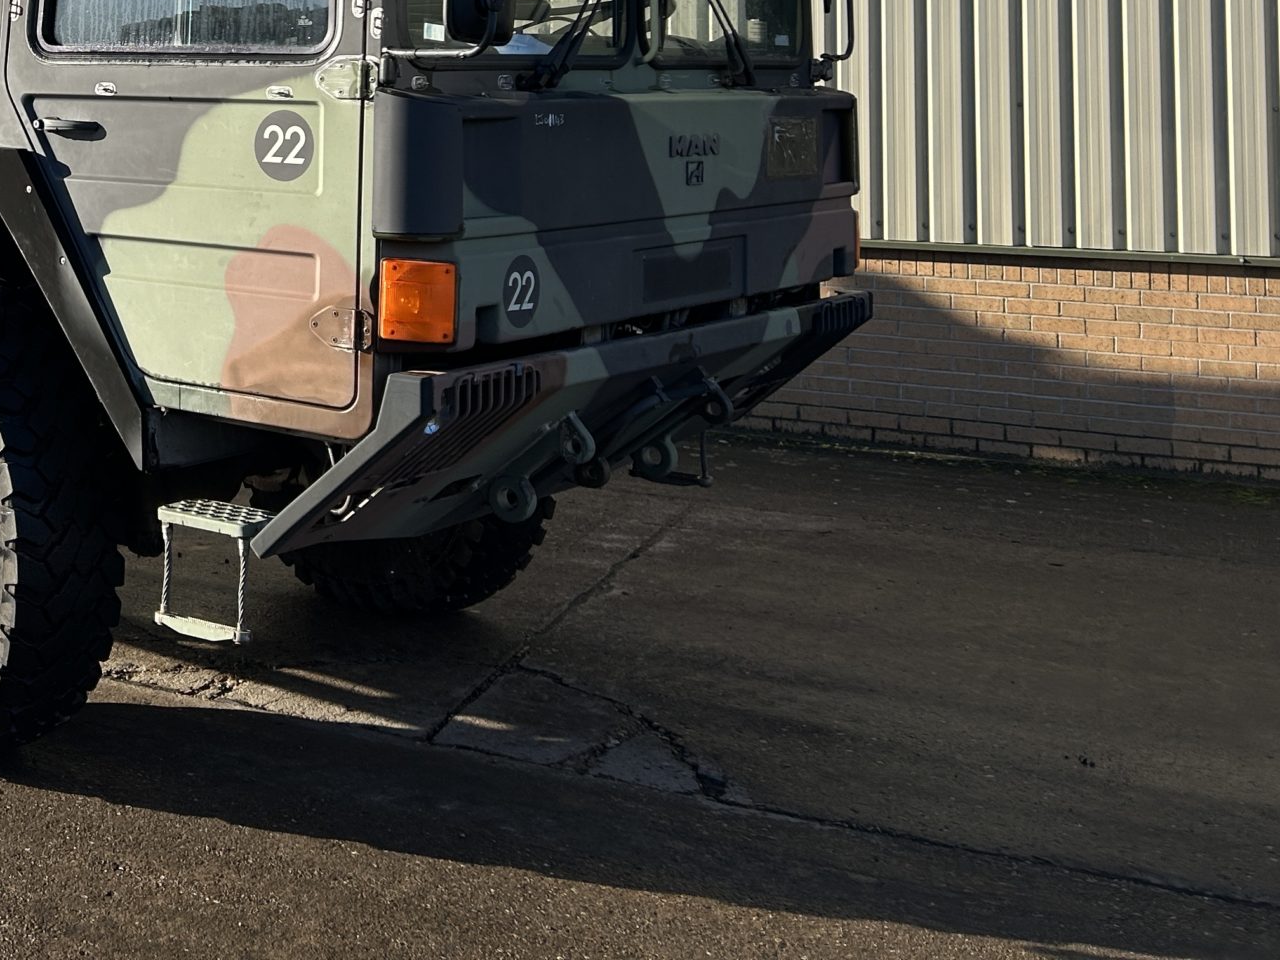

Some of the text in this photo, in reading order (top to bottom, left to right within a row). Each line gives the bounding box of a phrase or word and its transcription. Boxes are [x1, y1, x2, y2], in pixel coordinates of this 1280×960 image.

[262, 124, 306, 165] 22
[669, 134, 720, 158] MAN
[508, 270, 535, 312] 22
